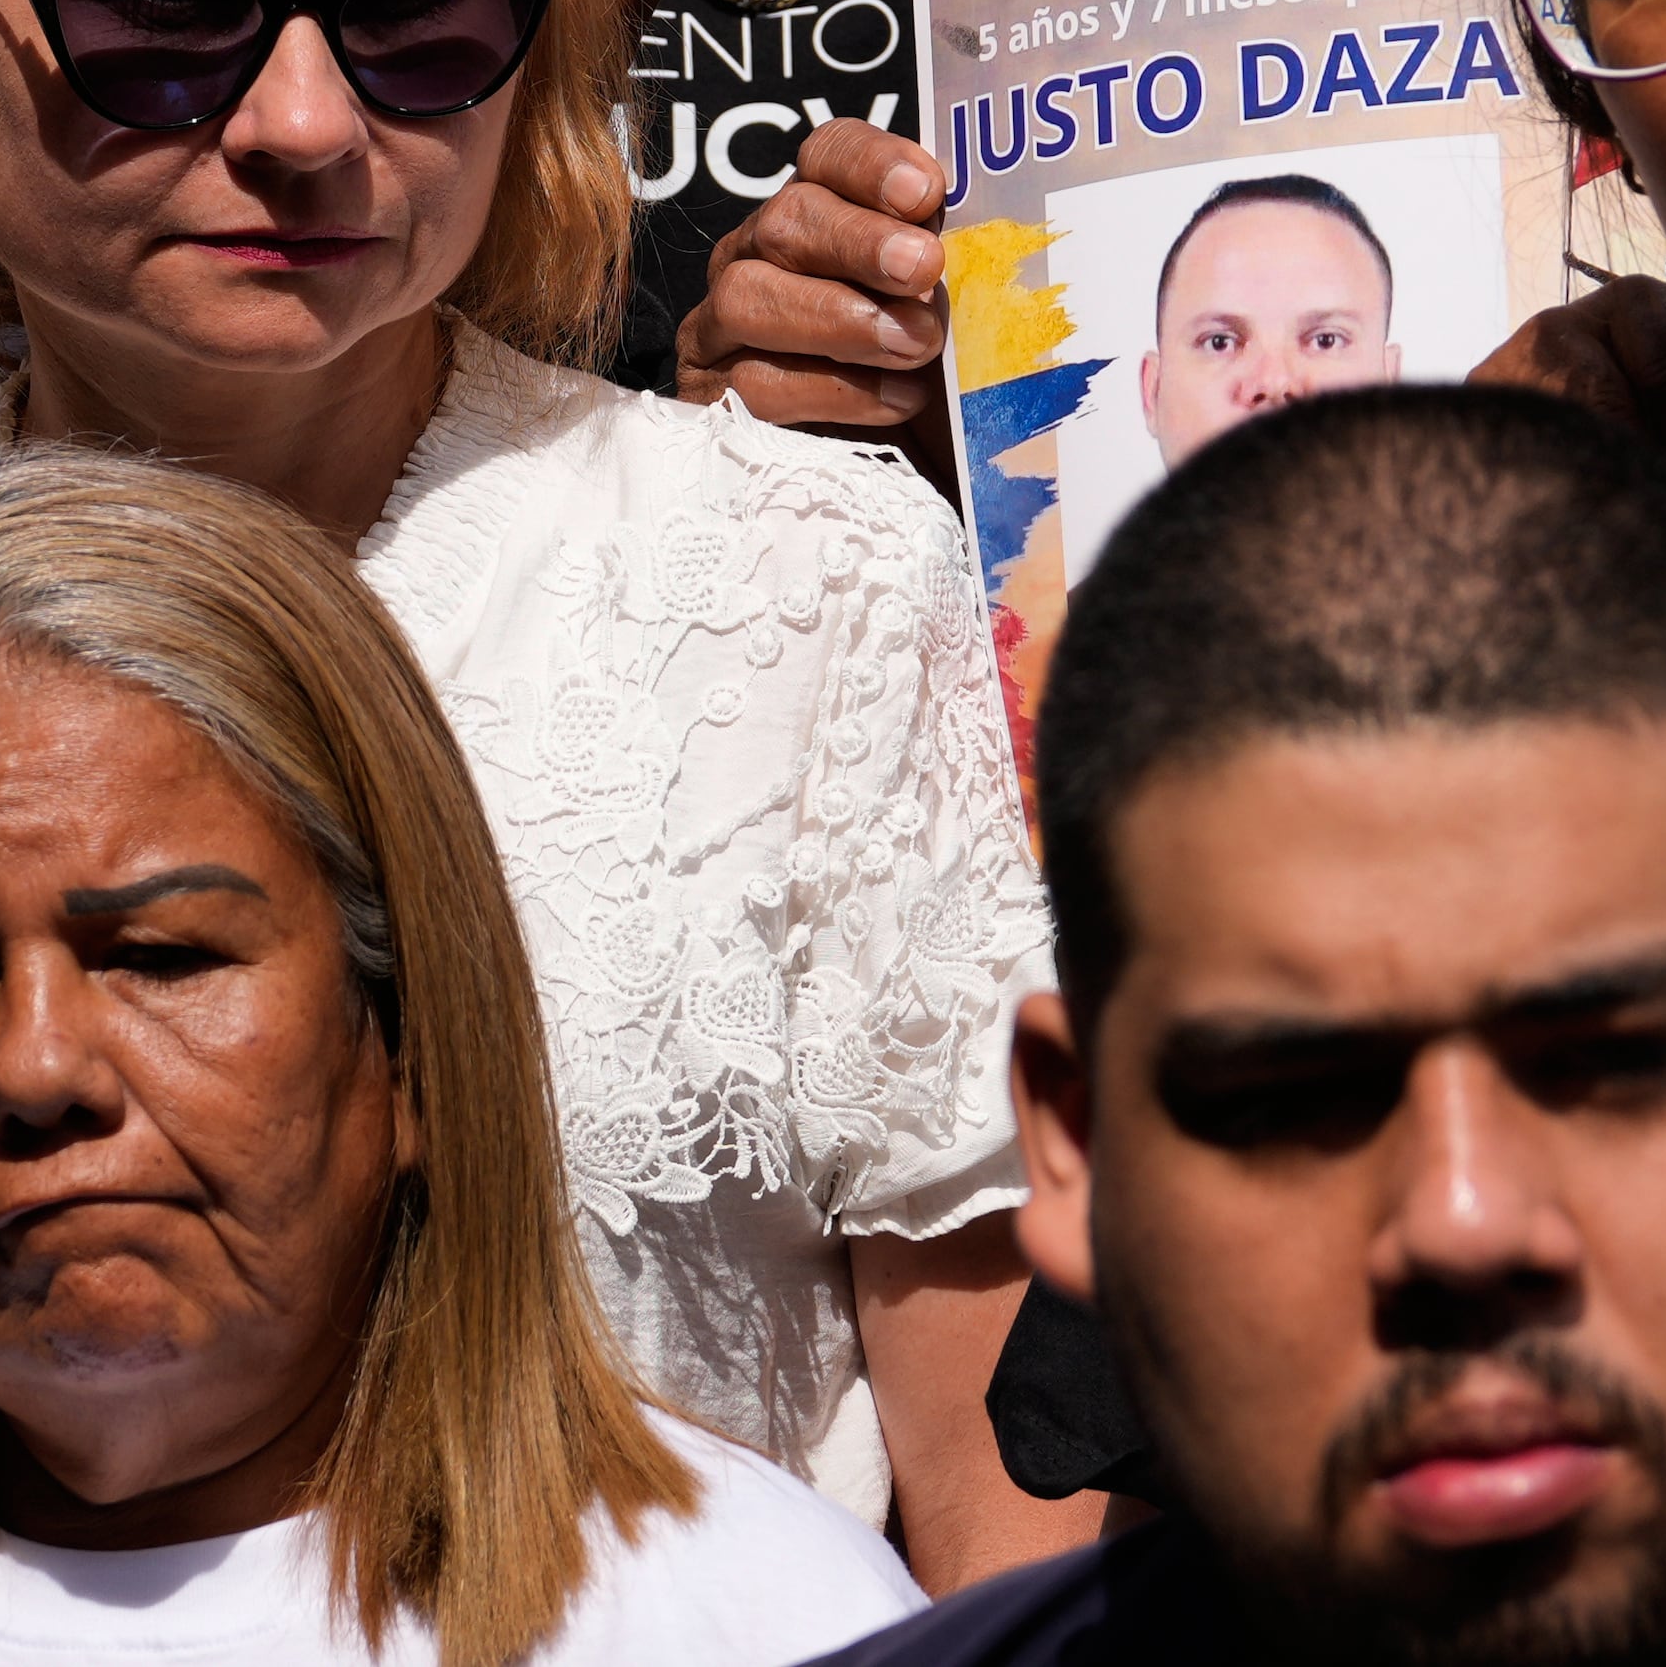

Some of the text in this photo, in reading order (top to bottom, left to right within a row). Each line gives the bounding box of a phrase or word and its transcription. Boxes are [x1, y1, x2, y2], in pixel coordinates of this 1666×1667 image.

[976, 22, 999, 63] 5
[1008, 4, 1100, 54] años
[944, 16, 1526, 209] JUSTO DAZA
